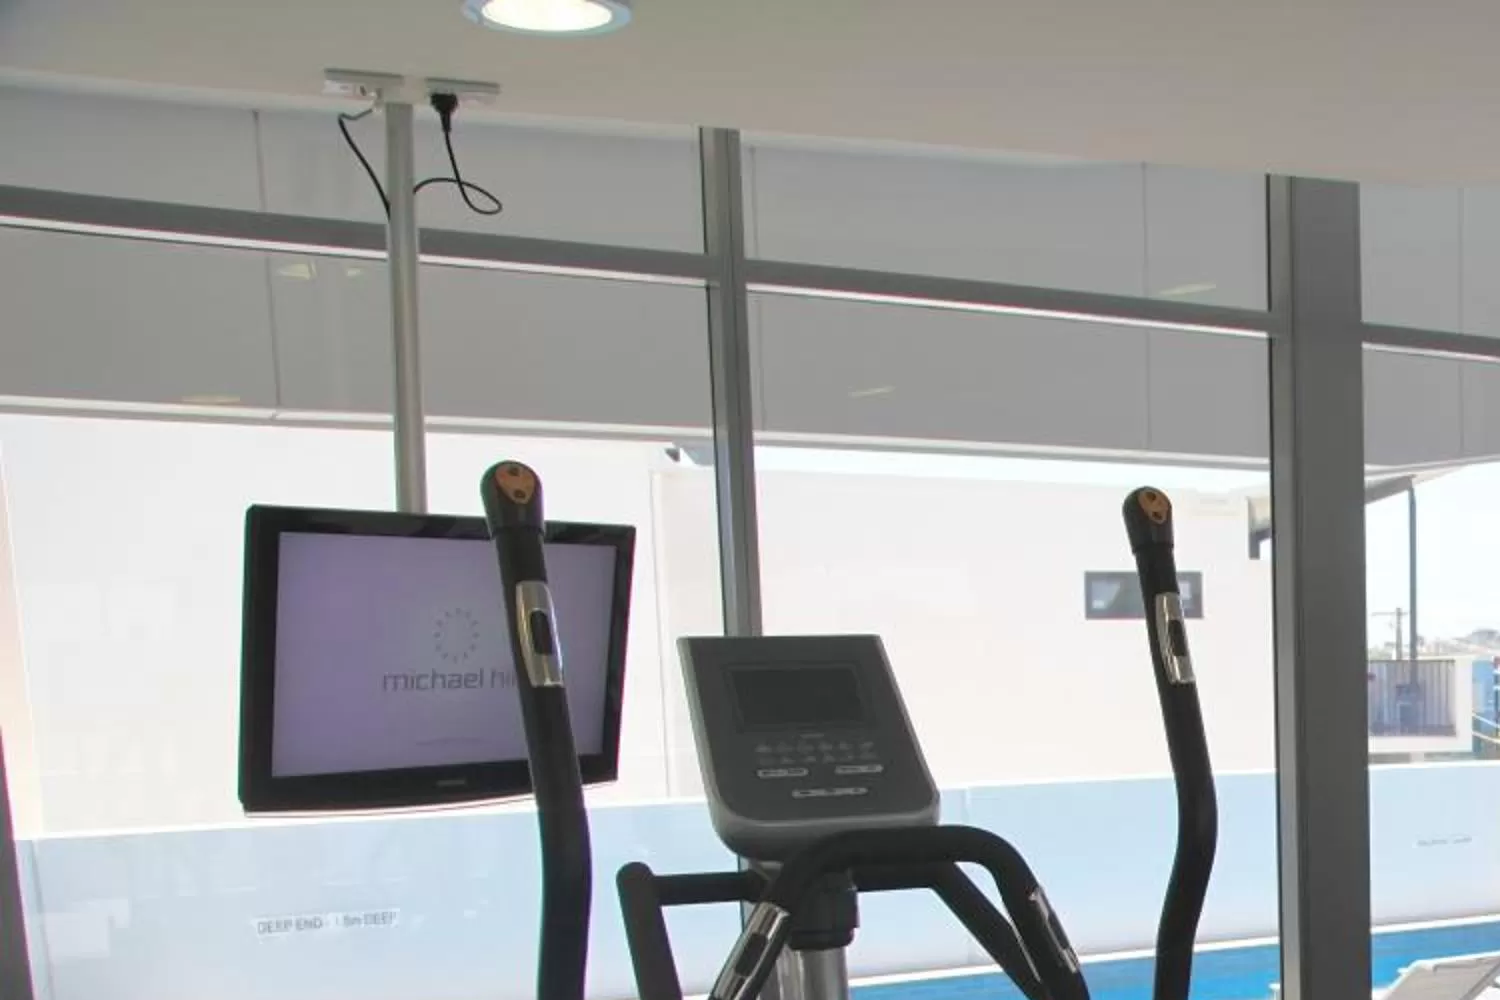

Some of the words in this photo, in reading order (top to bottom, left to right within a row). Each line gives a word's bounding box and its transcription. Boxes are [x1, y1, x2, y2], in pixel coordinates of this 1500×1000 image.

[383, 668, 485, 692] michael
[257, 919, 293, 934] DEEP
[295, 916, 323, 931] END
